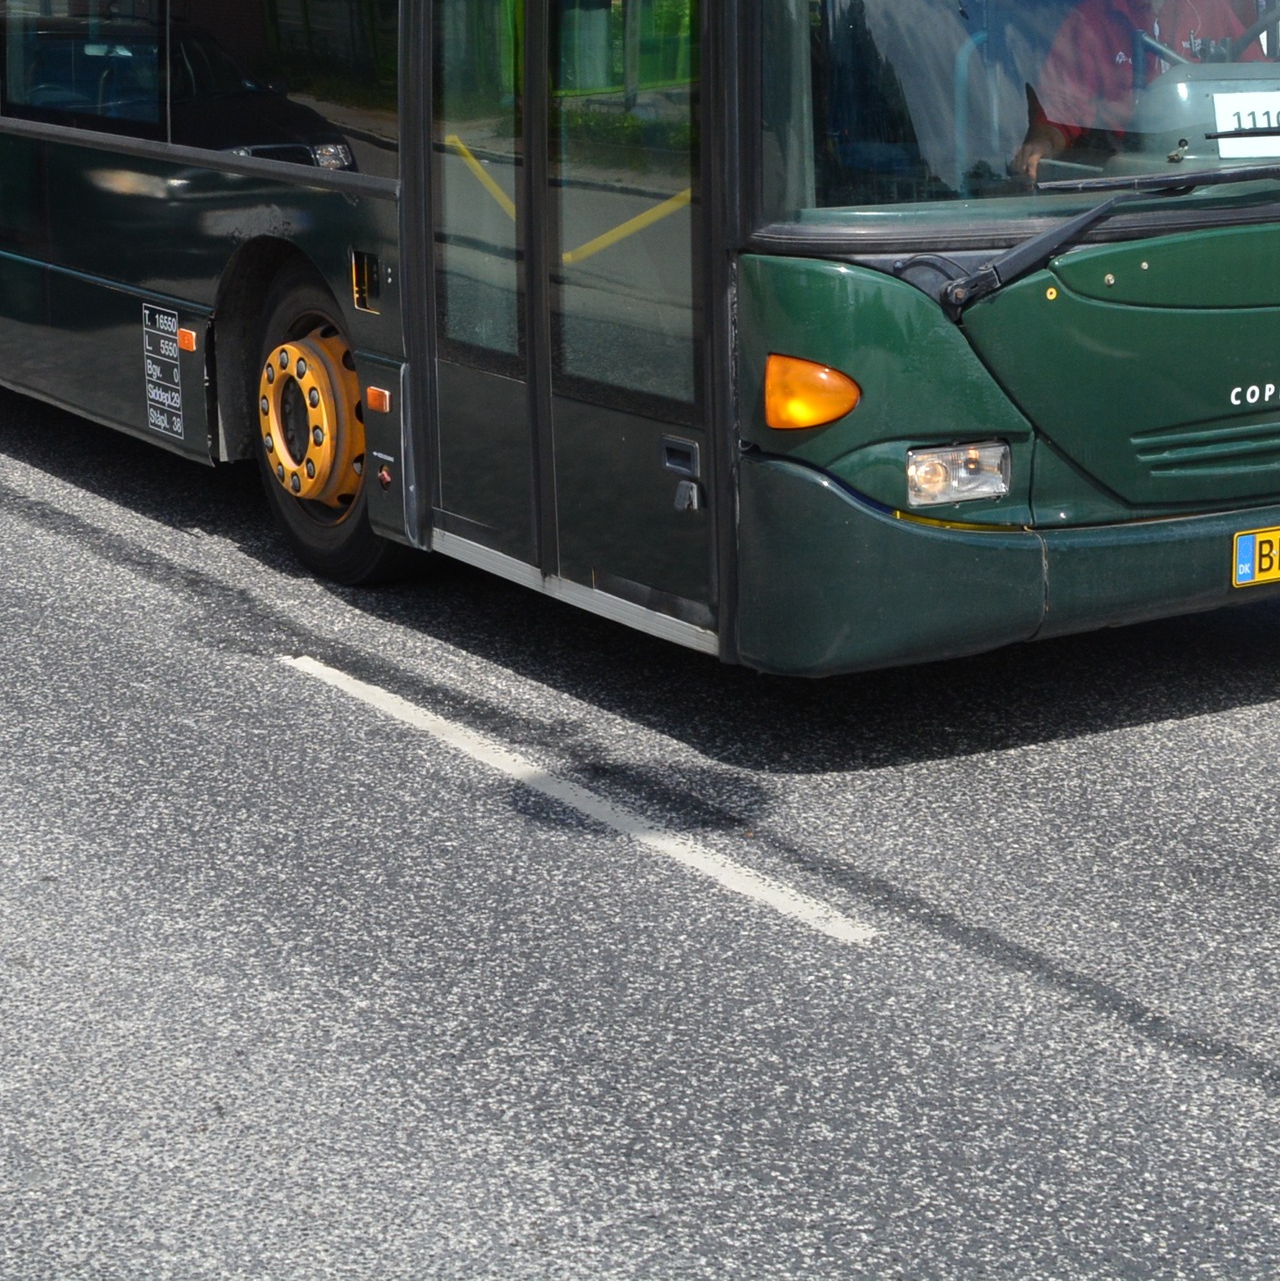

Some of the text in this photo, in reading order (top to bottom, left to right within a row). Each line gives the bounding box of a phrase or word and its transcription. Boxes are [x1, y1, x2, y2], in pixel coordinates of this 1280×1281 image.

[144, 309, 177, 333] T. 16550
[146, 335, 178, 358] L 5550
[147, 359, 179, 383] Bgv. 0
[171, 416, 182, 433] 38
[1238, 563, 1251, 575] DK
